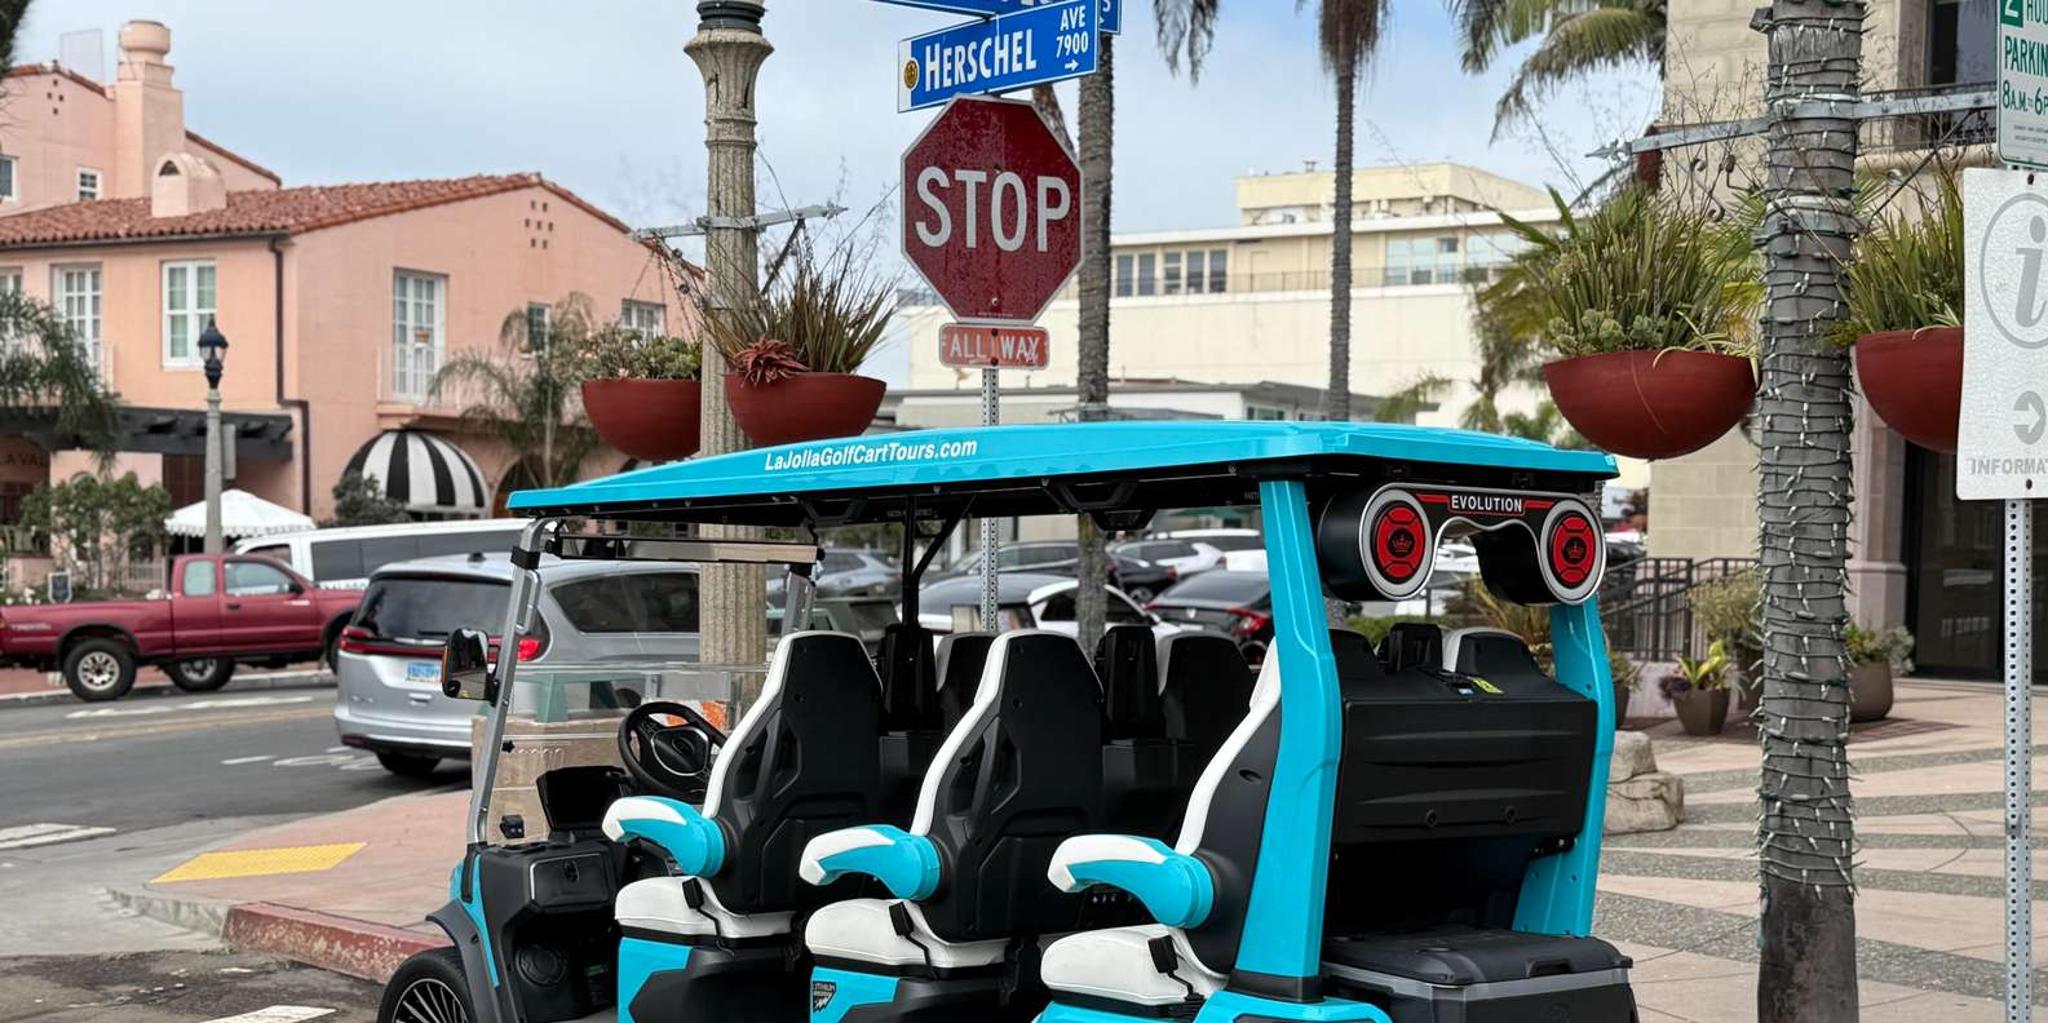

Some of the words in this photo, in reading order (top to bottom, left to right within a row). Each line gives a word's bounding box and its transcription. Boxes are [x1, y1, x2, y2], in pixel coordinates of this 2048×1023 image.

[1060, 6, 1086, 31] AVE
[1056, 31, 1089, 59] 7900
[925, 29, 1037, 92] HERSCHEL
[915, 166, 1071, 252] STOP
[950, 333, 987, 358] ALL
[1000, 335, 1040, 361] WAY
[765, 440, 978, 471] LaJollaGolfCartTours.com
[1451, 495, 1522, 512] EVOLUTION
